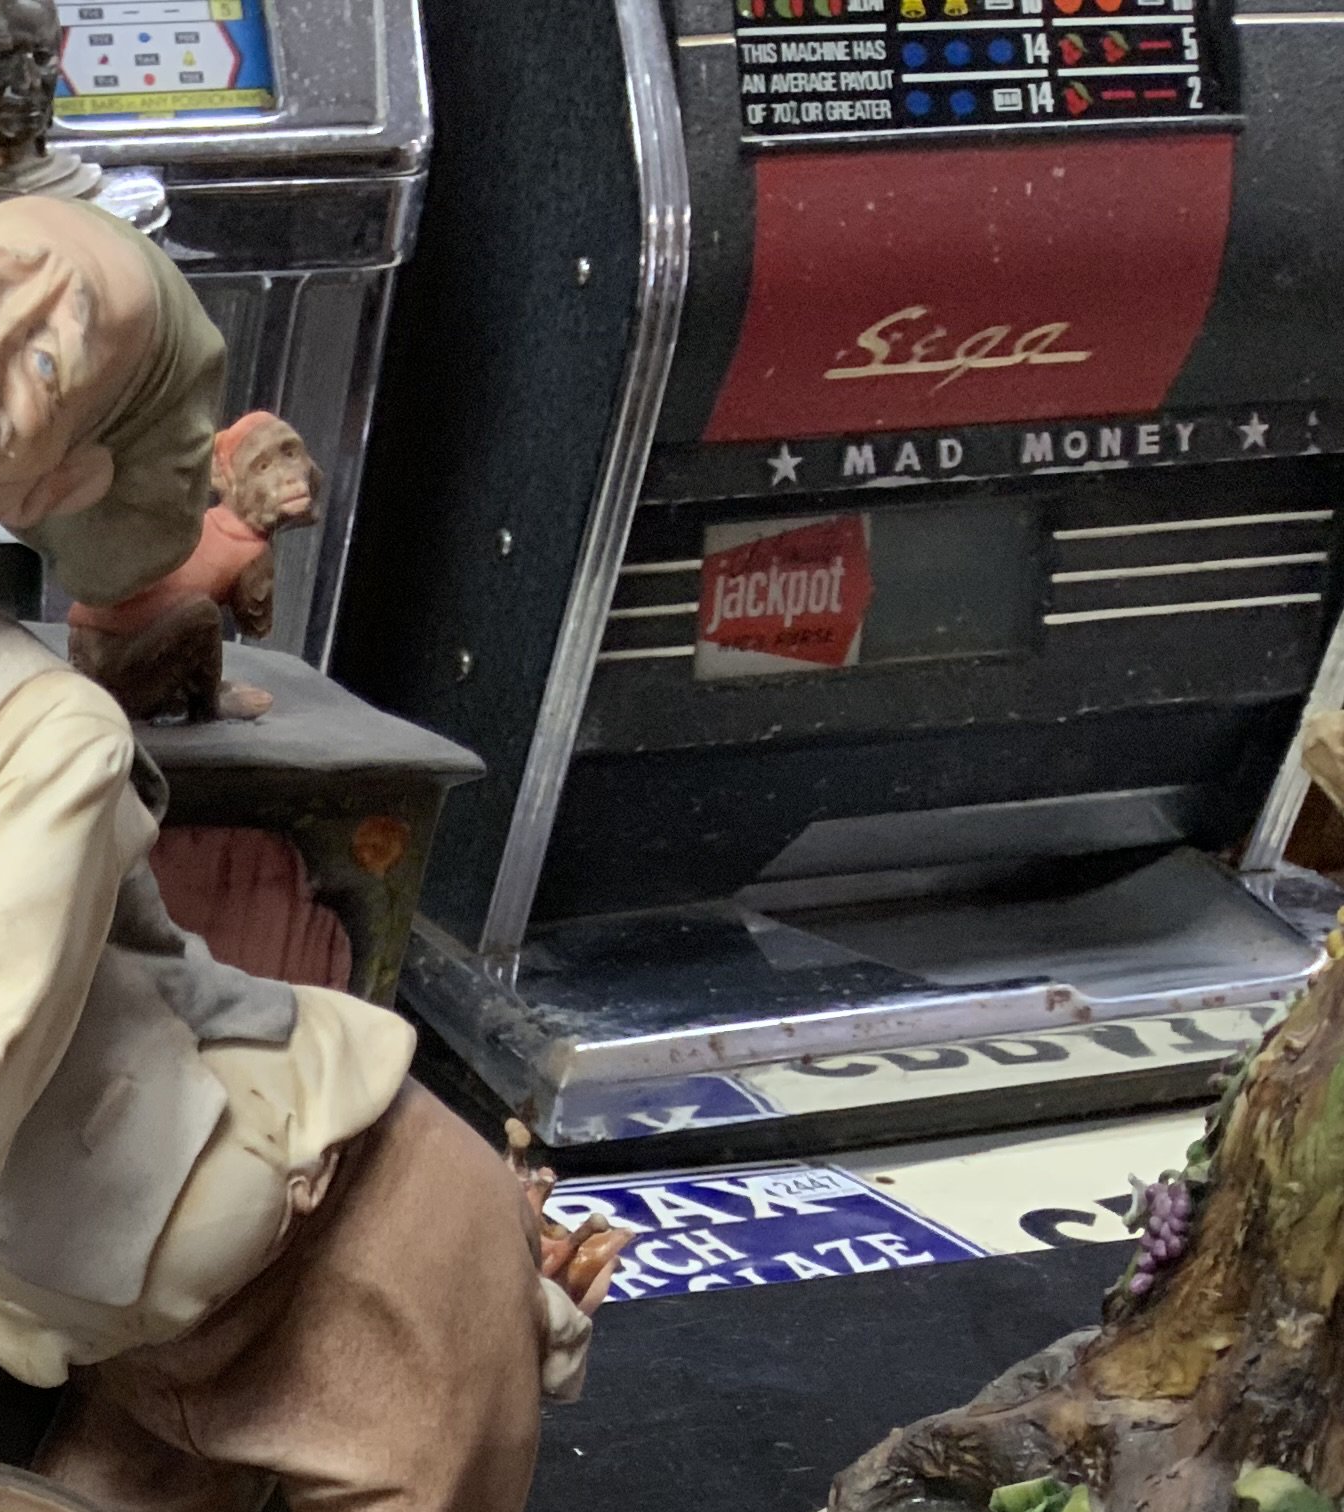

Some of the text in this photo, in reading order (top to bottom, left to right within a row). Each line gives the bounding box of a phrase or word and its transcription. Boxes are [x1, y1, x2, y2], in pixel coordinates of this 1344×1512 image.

[740, 39, 887, 64] THIS MACHINE HAS
[1023, 33, 1051, 65] 14
[1181, 26, 1200, 61] 5
[742, 69, 895, 94] AN AVERAGE PAYOUT
[1028, 81, 1055, 114] 14
[1186, 76, 1204, 109] 2
[746, 99, 892, 125] OF 70% OR GREATER
[823, 304, 1093, 397] Sega
[842, 422, 1195, 477] MAD MONEY
[706, 556, 846, 635] jackpot
[541, 1175, 837, 1236] RAX
[605, 1228, 748, 1299] RCH
[688, 1231, 935, 1294] AZE
